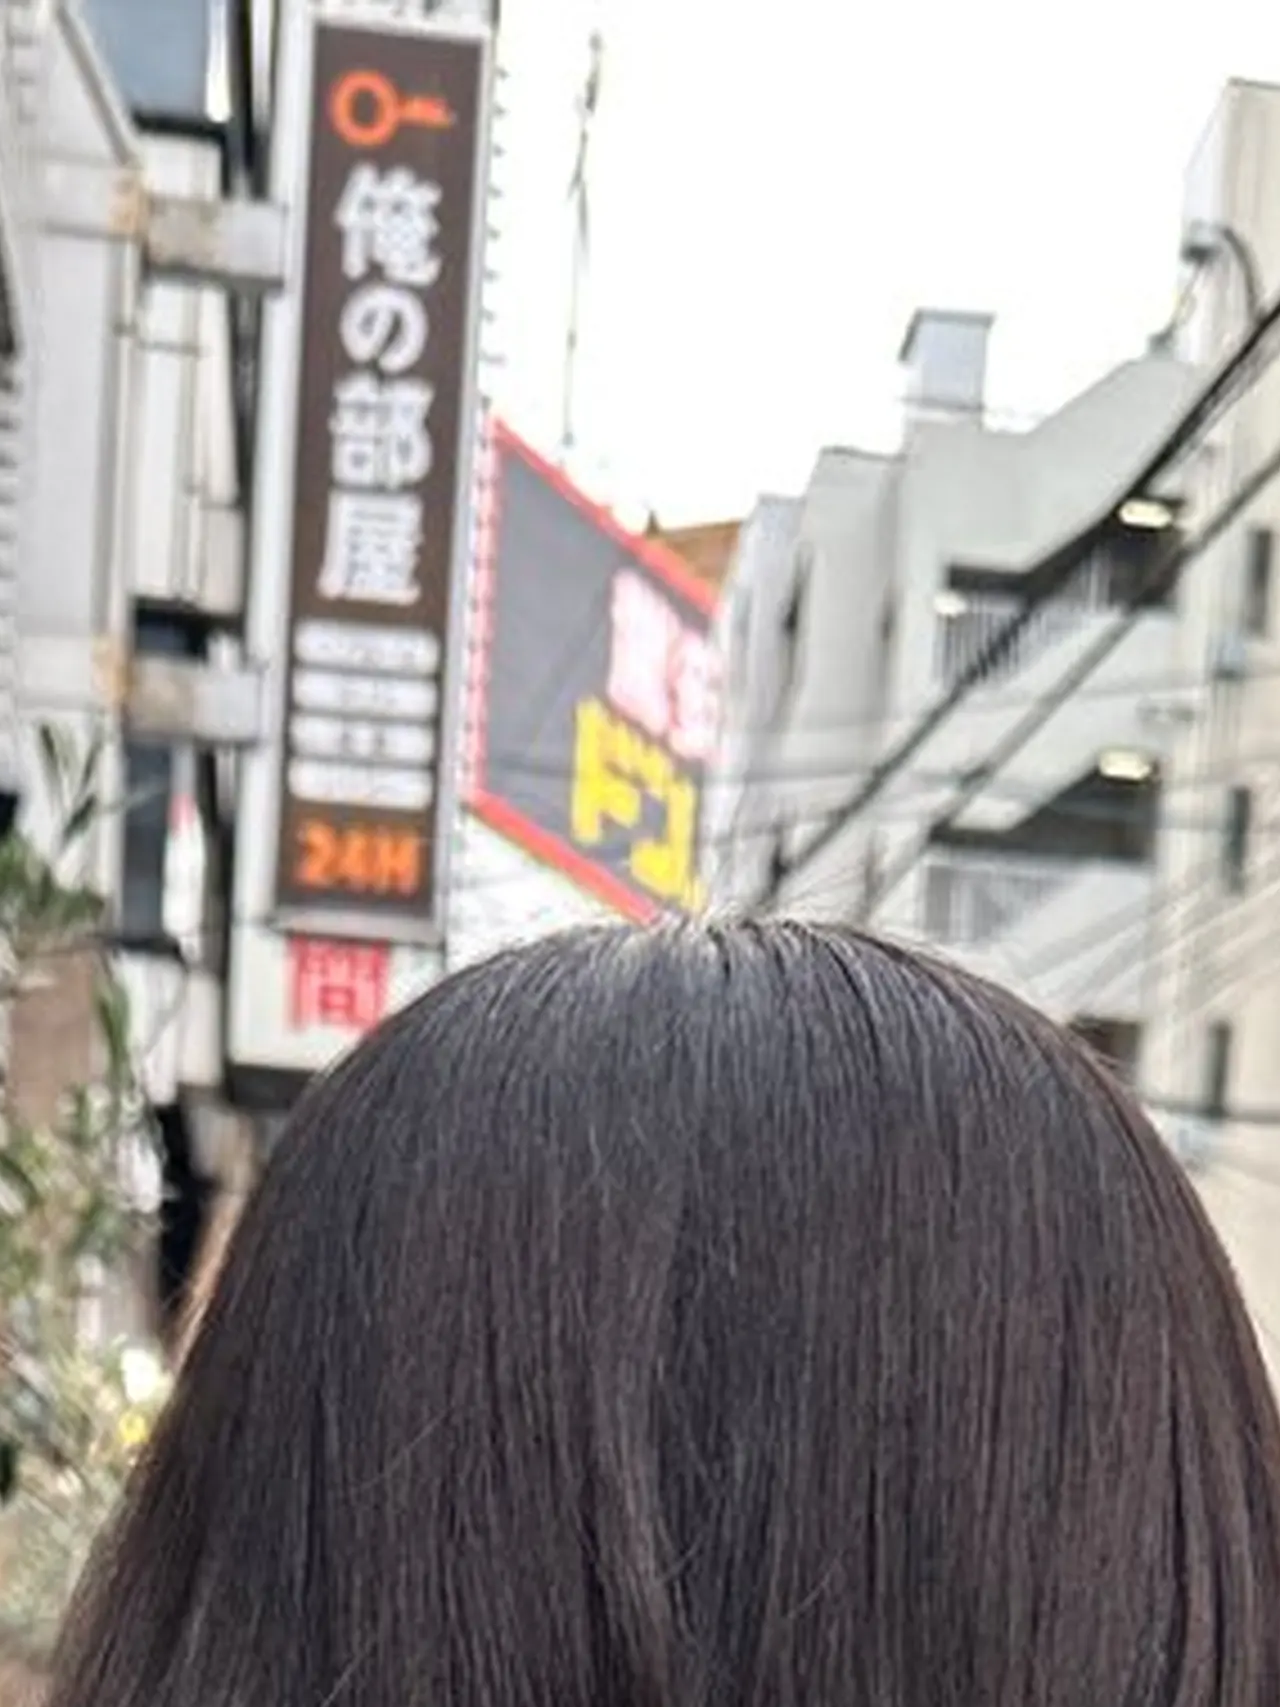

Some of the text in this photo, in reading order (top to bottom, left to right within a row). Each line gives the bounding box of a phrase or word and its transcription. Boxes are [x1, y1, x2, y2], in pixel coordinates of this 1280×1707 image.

[318, 163, 443, 606] 俺の部屋
[295, 820, 420, 896] 24H
